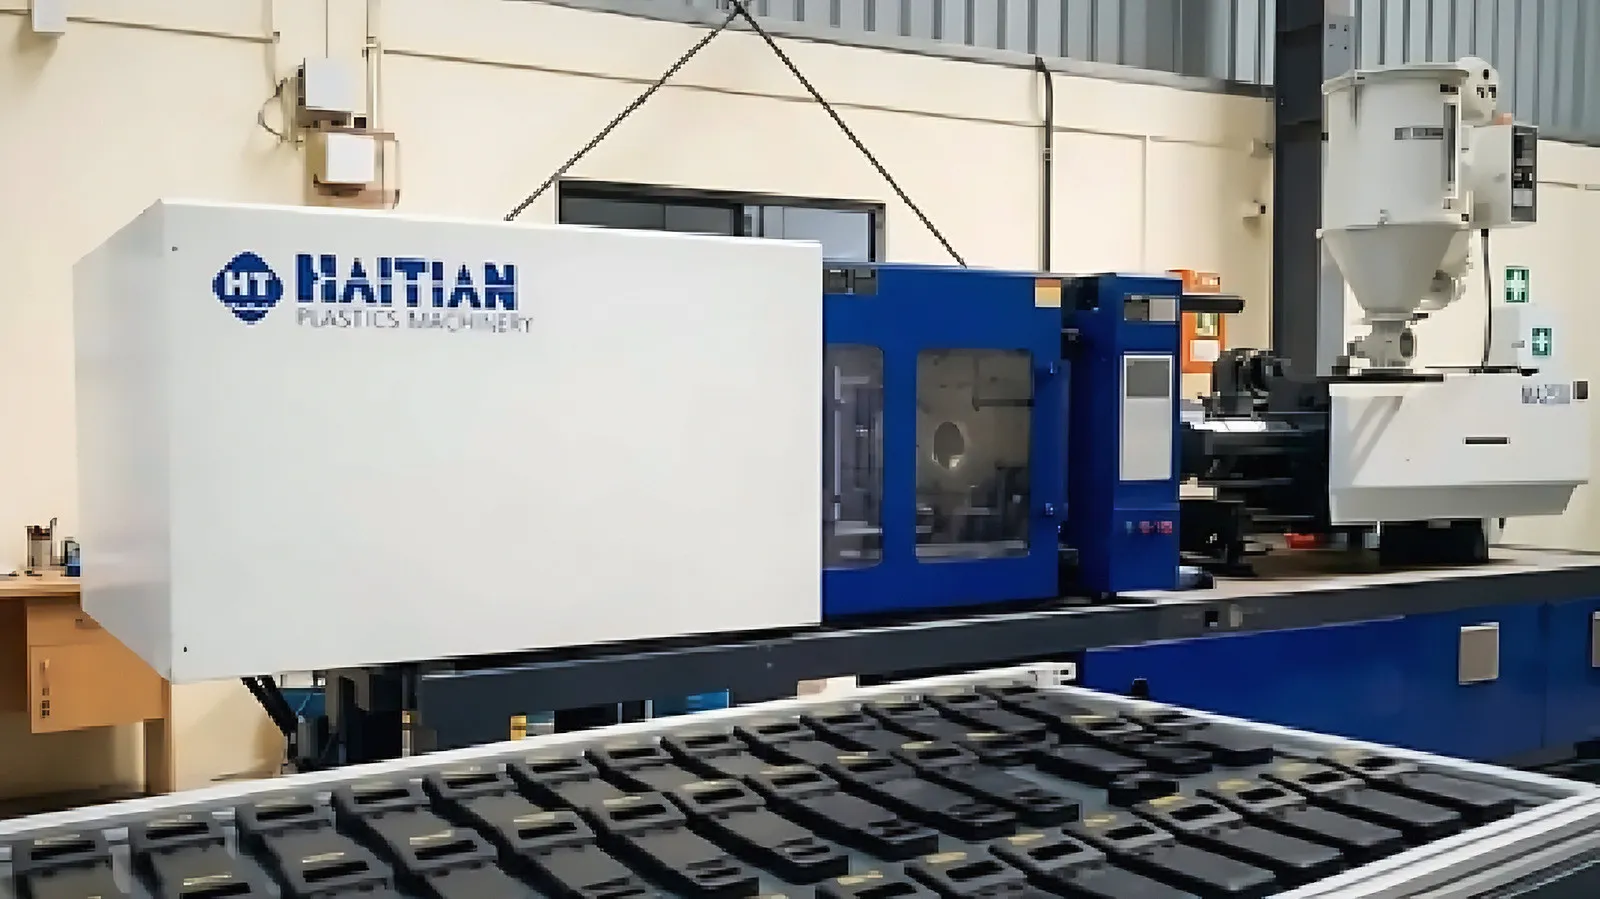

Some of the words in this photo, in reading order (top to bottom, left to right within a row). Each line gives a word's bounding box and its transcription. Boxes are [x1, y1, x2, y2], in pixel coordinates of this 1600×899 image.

[224, 271, 268, 297] HT
[296, 253, 518, 311] HAITIAN
[296, 306, 400, 329] PLASTICS
